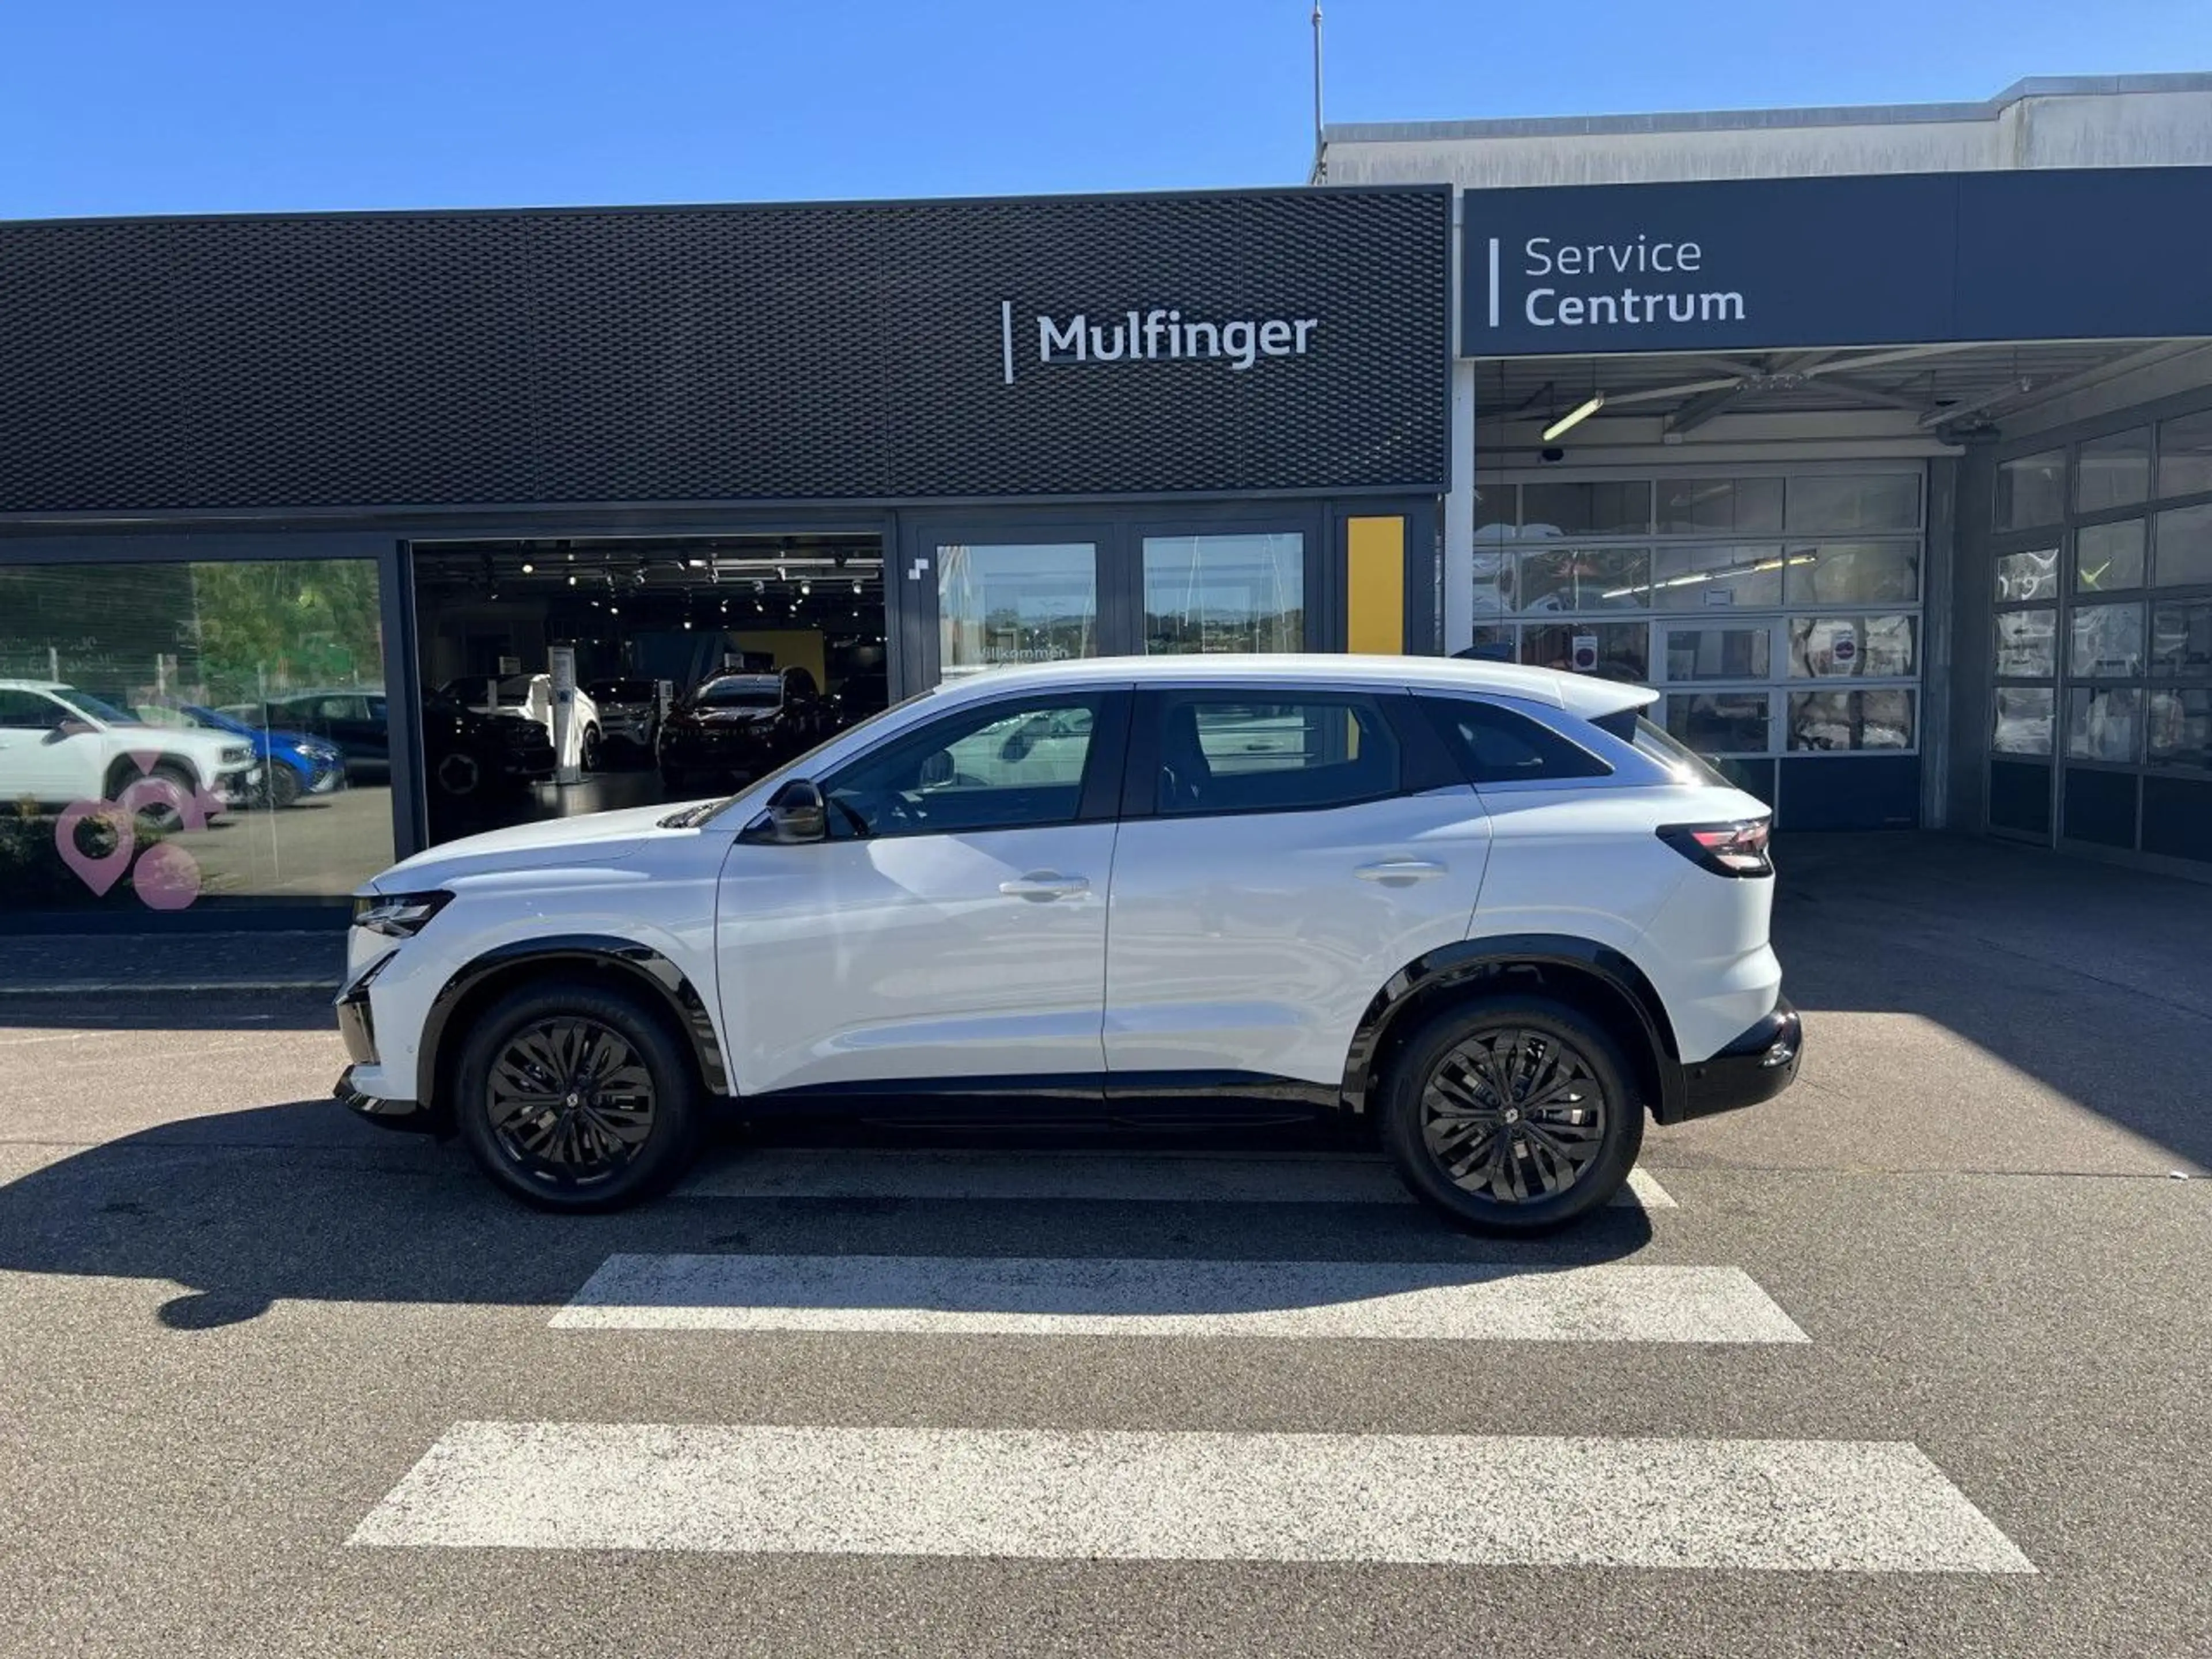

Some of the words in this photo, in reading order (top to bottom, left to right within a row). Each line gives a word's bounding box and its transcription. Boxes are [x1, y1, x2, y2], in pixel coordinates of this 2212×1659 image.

[1525, 233, 1702, 275] Service
[1525, 289, 1745, 326] Centrum
[1037, 310, 1318, 369] Mulfinger
